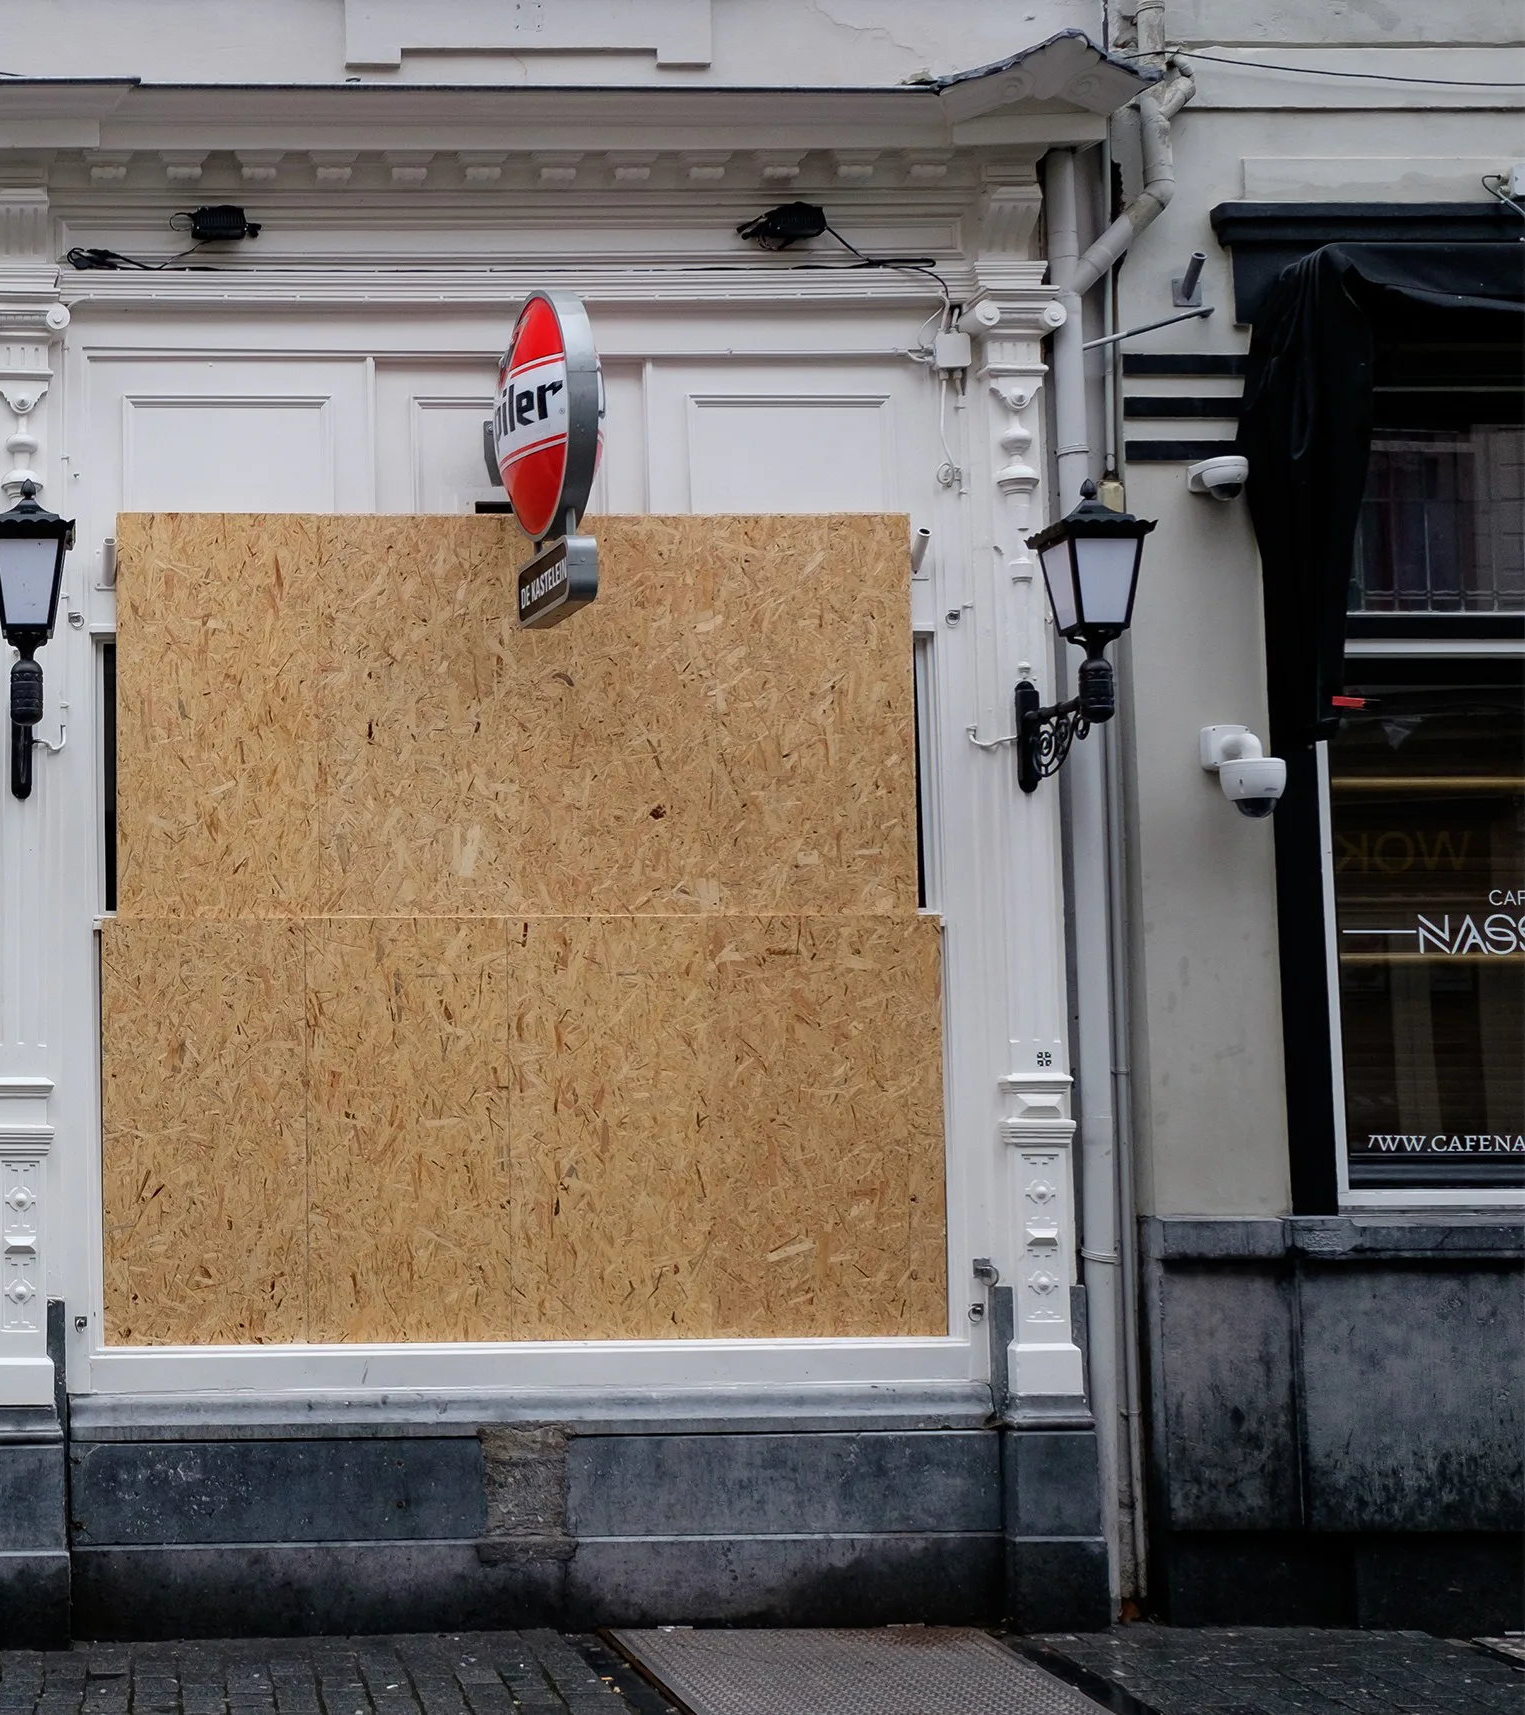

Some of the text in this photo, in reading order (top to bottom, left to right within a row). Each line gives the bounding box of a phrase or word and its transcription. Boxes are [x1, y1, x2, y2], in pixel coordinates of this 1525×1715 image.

[520, 557, 567, 610] DE KASTELEIN
[1417, 914, 1525, 955] NAS
